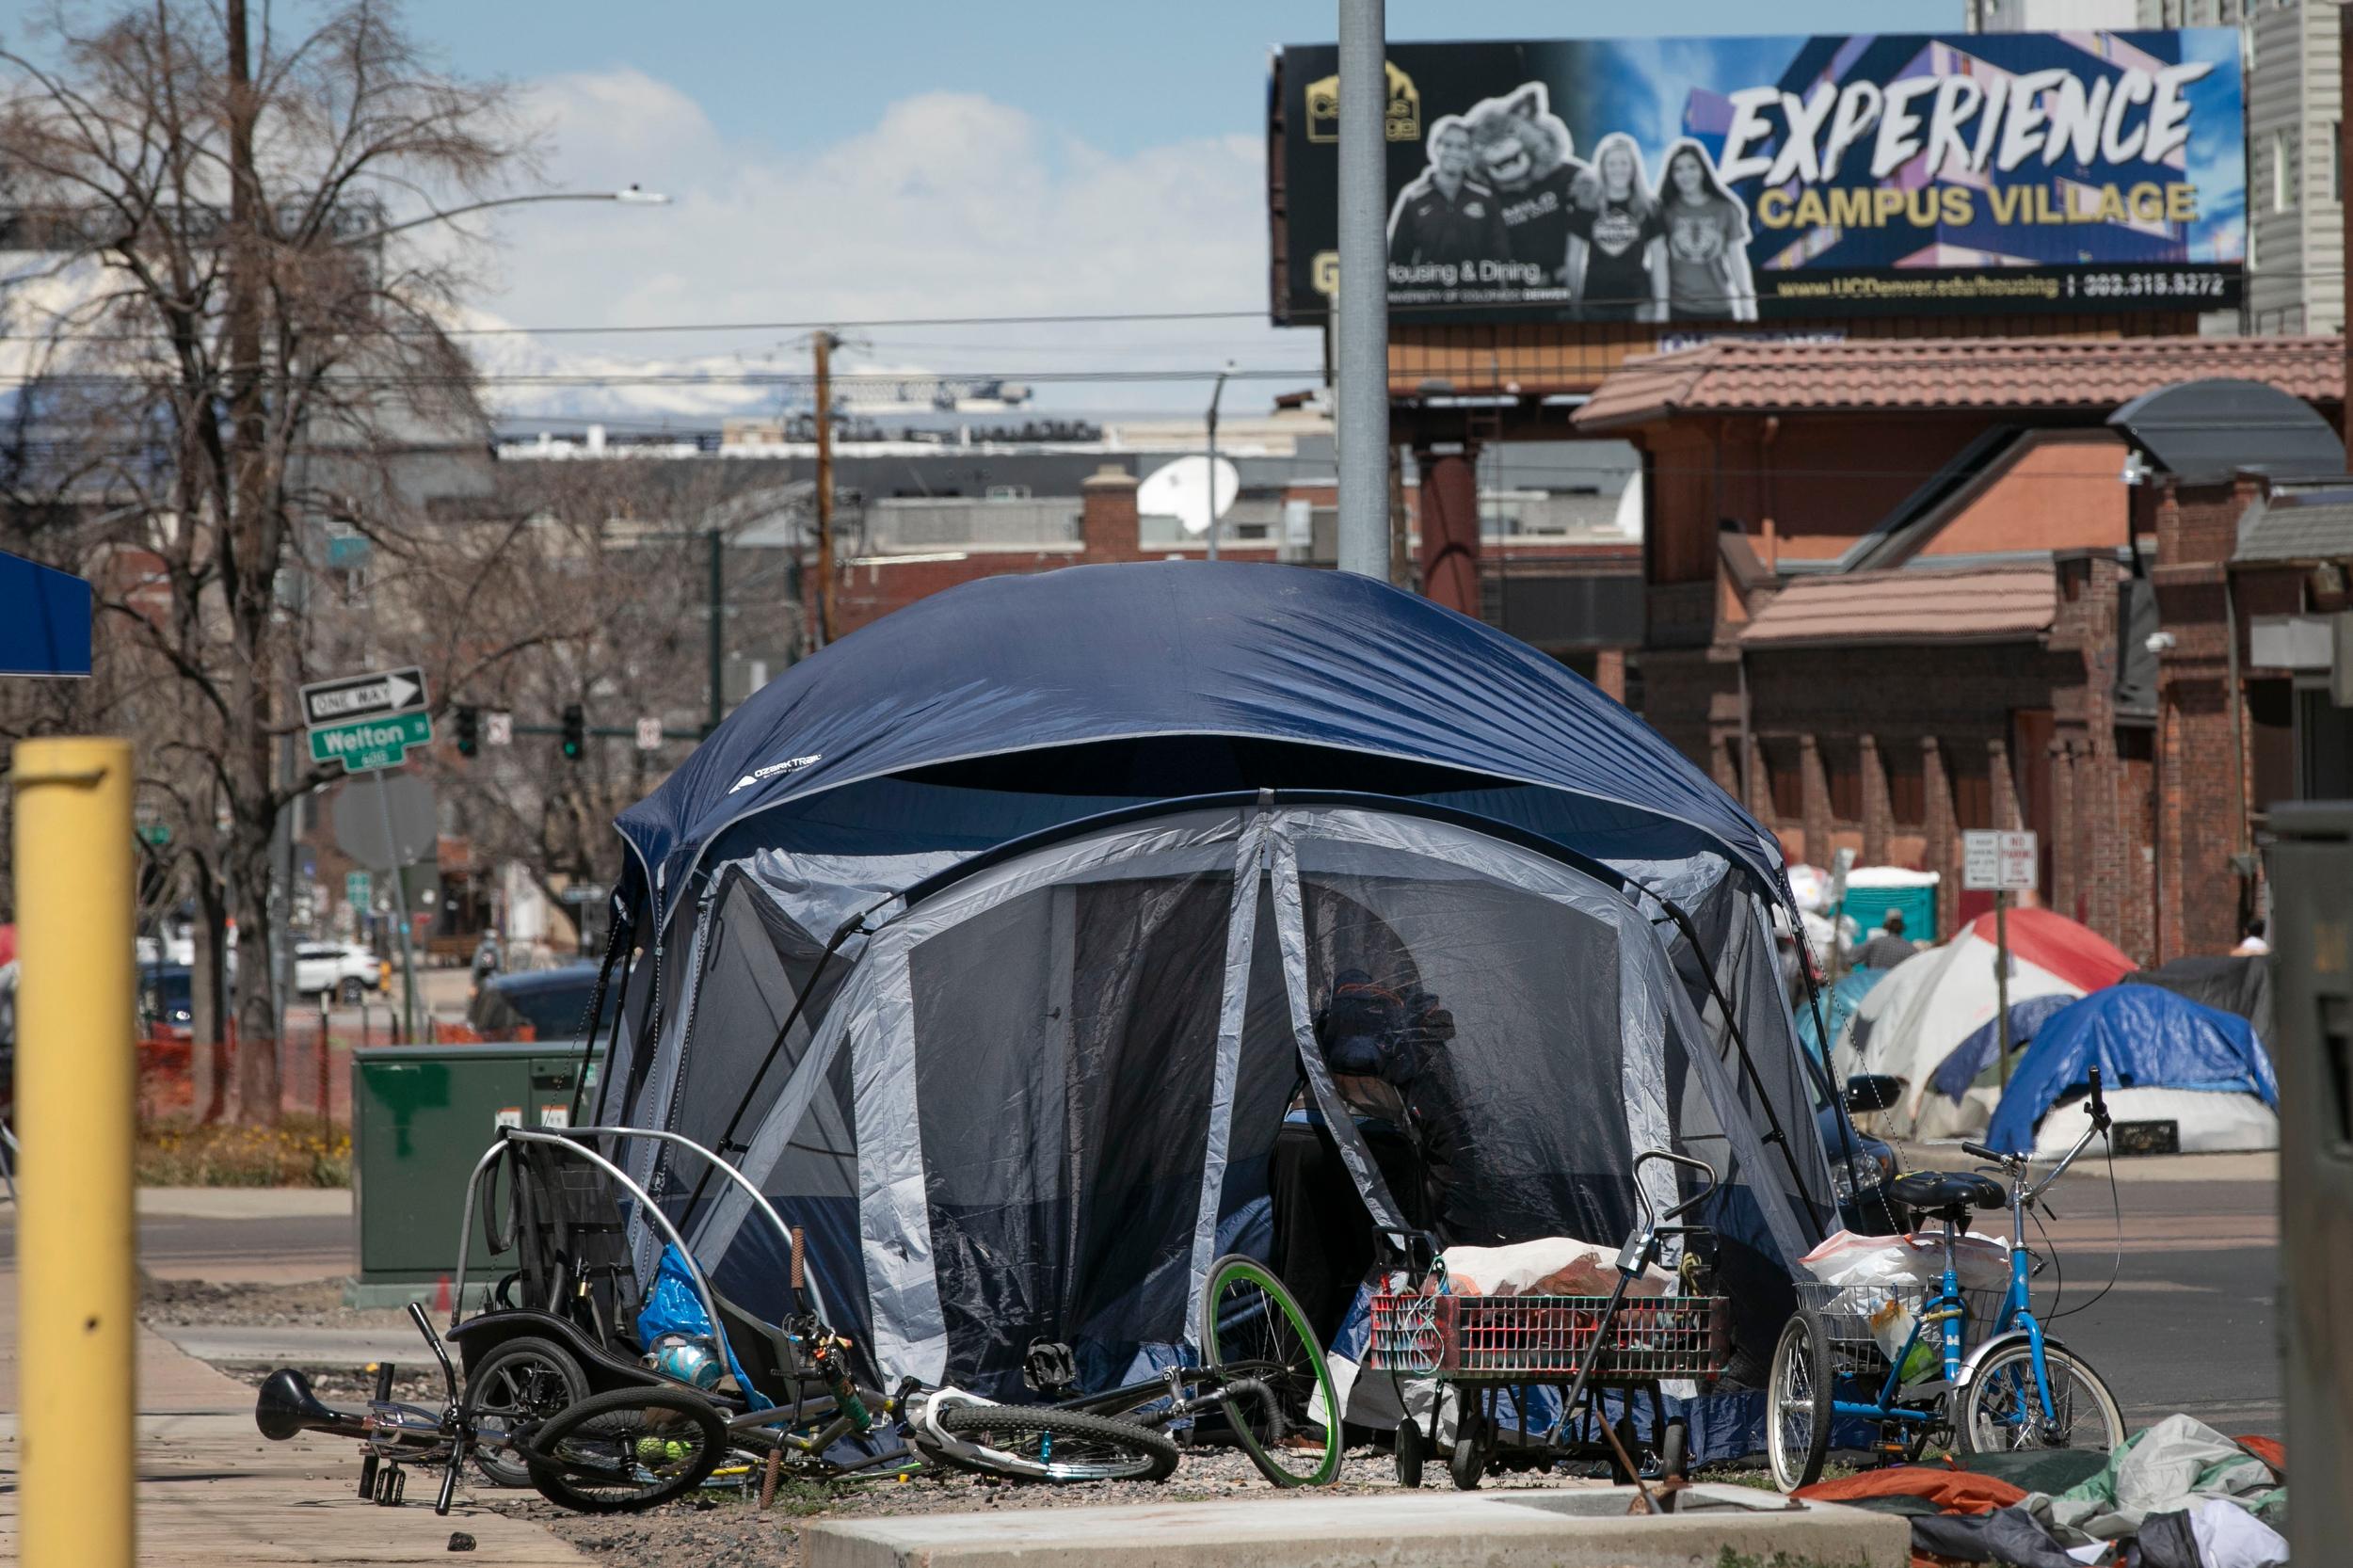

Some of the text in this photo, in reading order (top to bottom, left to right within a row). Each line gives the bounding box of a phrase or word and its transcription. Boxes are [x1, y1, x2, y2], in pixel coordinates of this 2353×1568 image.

[1720, 61, 2215, 186] EXPERIENCE
[1757, 183, 2199, 229] CAMPUS VILLAGE
[1461, 261, 1477, 281] &
[1479, 260, 1541, 286] Dining
[315, 684, 389, 711] ONE WAY
[323, 725, 405, 753] Welton
